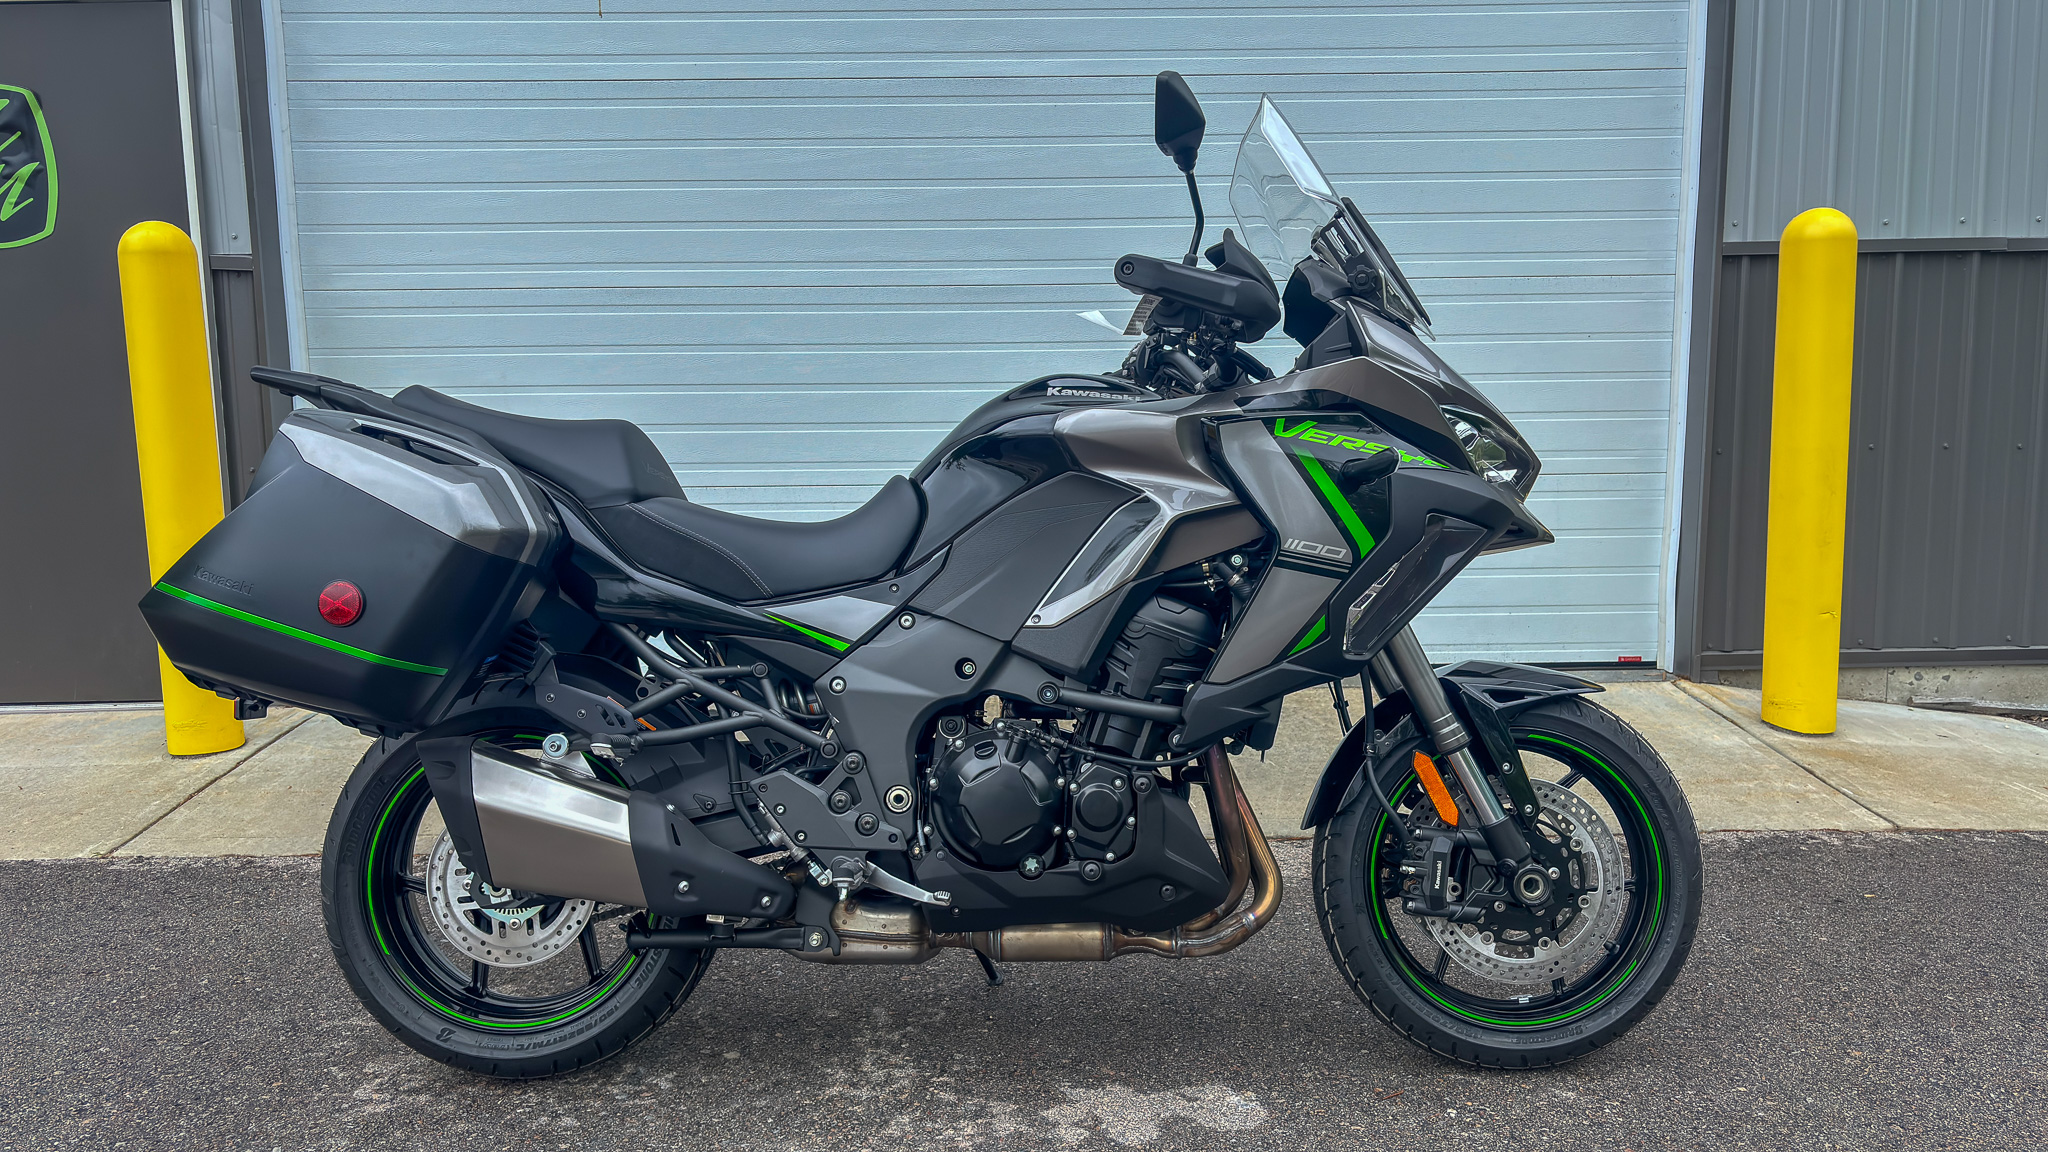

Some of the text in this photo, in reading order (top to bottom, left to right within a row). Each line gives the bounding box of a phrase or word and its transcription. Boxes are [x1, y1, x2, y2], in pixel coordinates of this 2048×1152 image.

[1046, 387, 1141, 402] Kawasaki
[1284, 538, 1347, 559] 1100
[193, 565, 254, 596] Kawasaki
[1434, 860, 1442, 889] Kawasaki
